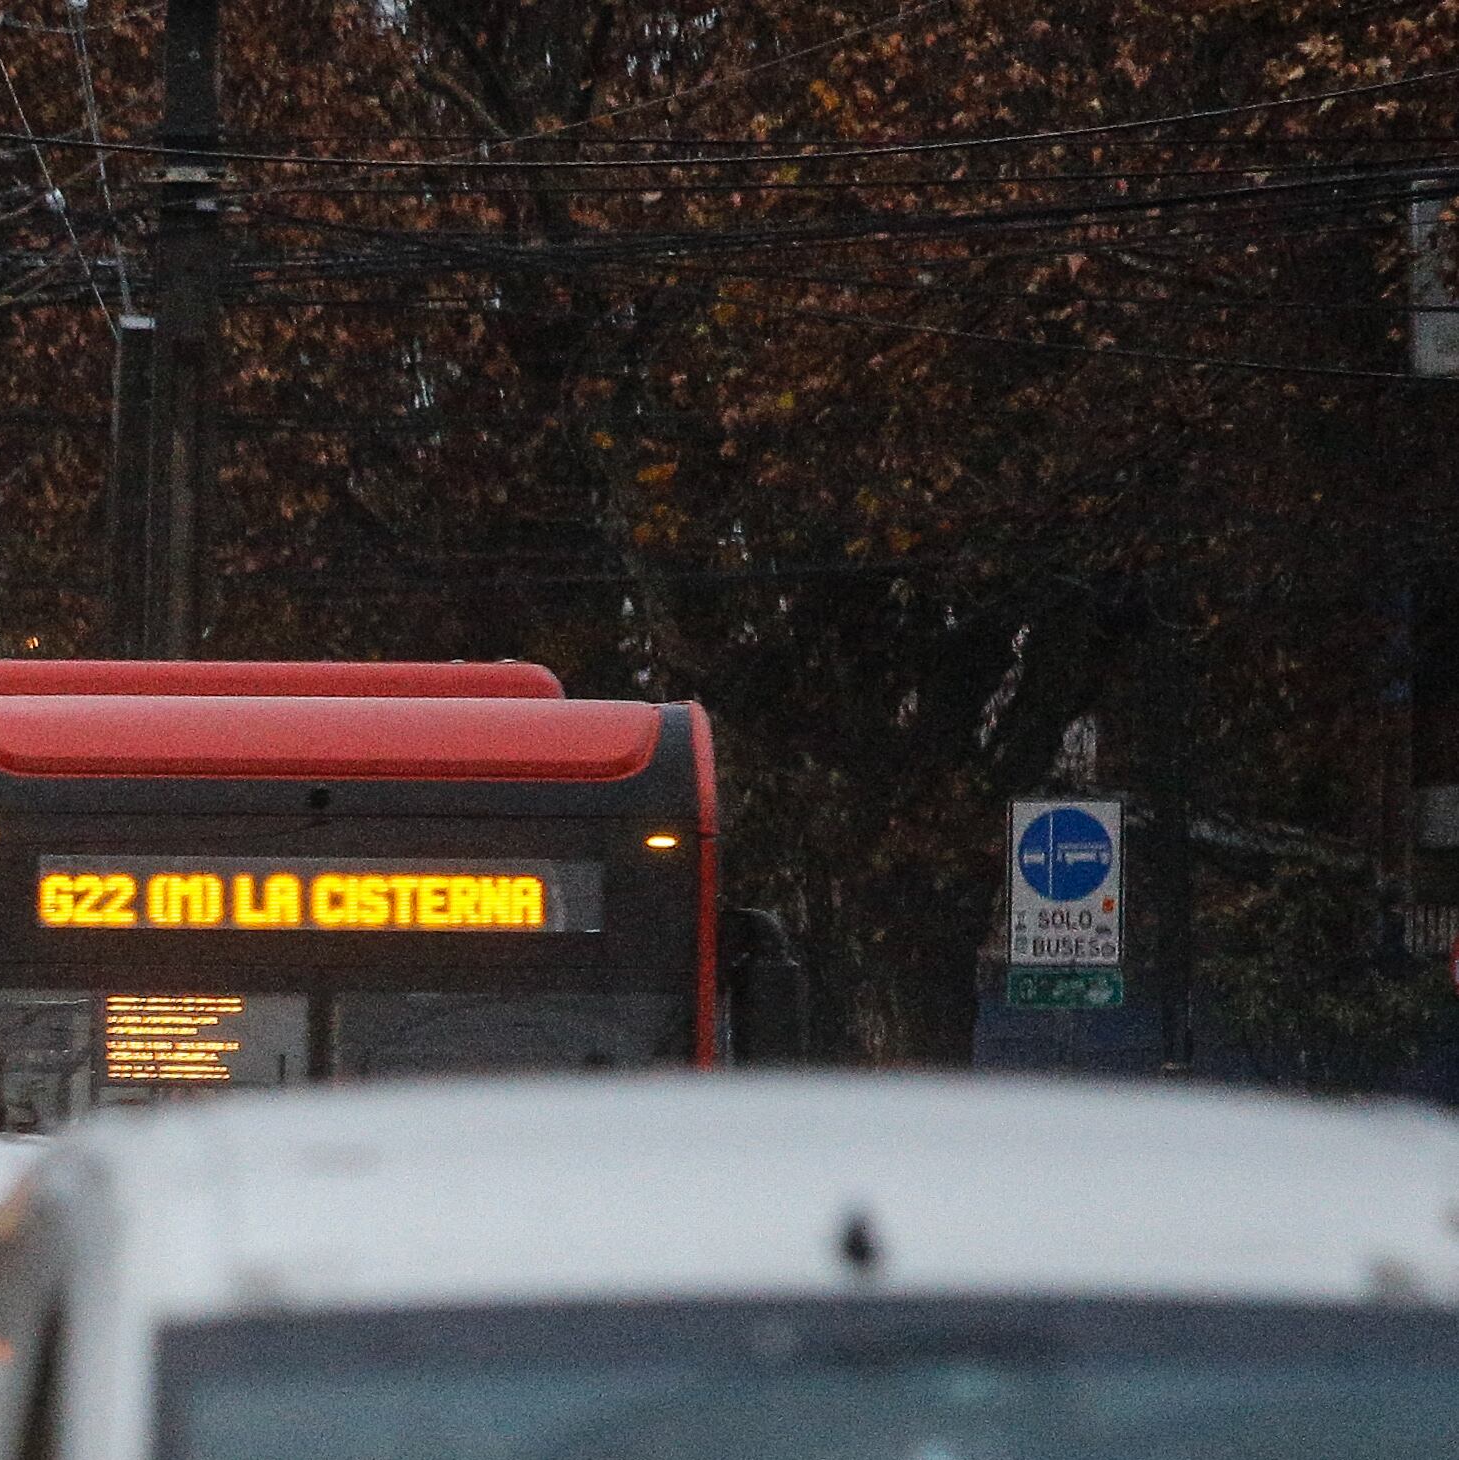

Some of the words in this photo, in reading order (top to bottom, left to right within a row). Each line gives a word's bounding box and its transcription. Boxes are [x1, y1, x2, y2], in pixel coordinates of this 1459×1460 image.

[38, 873, 137, 926] G22
[148, 873, 224, 926] (M)
[232, 873, 301, 928] LA
[312, 873, 546, 928] CISTERNA
[1038, 908, 1092, 931] SOLO
